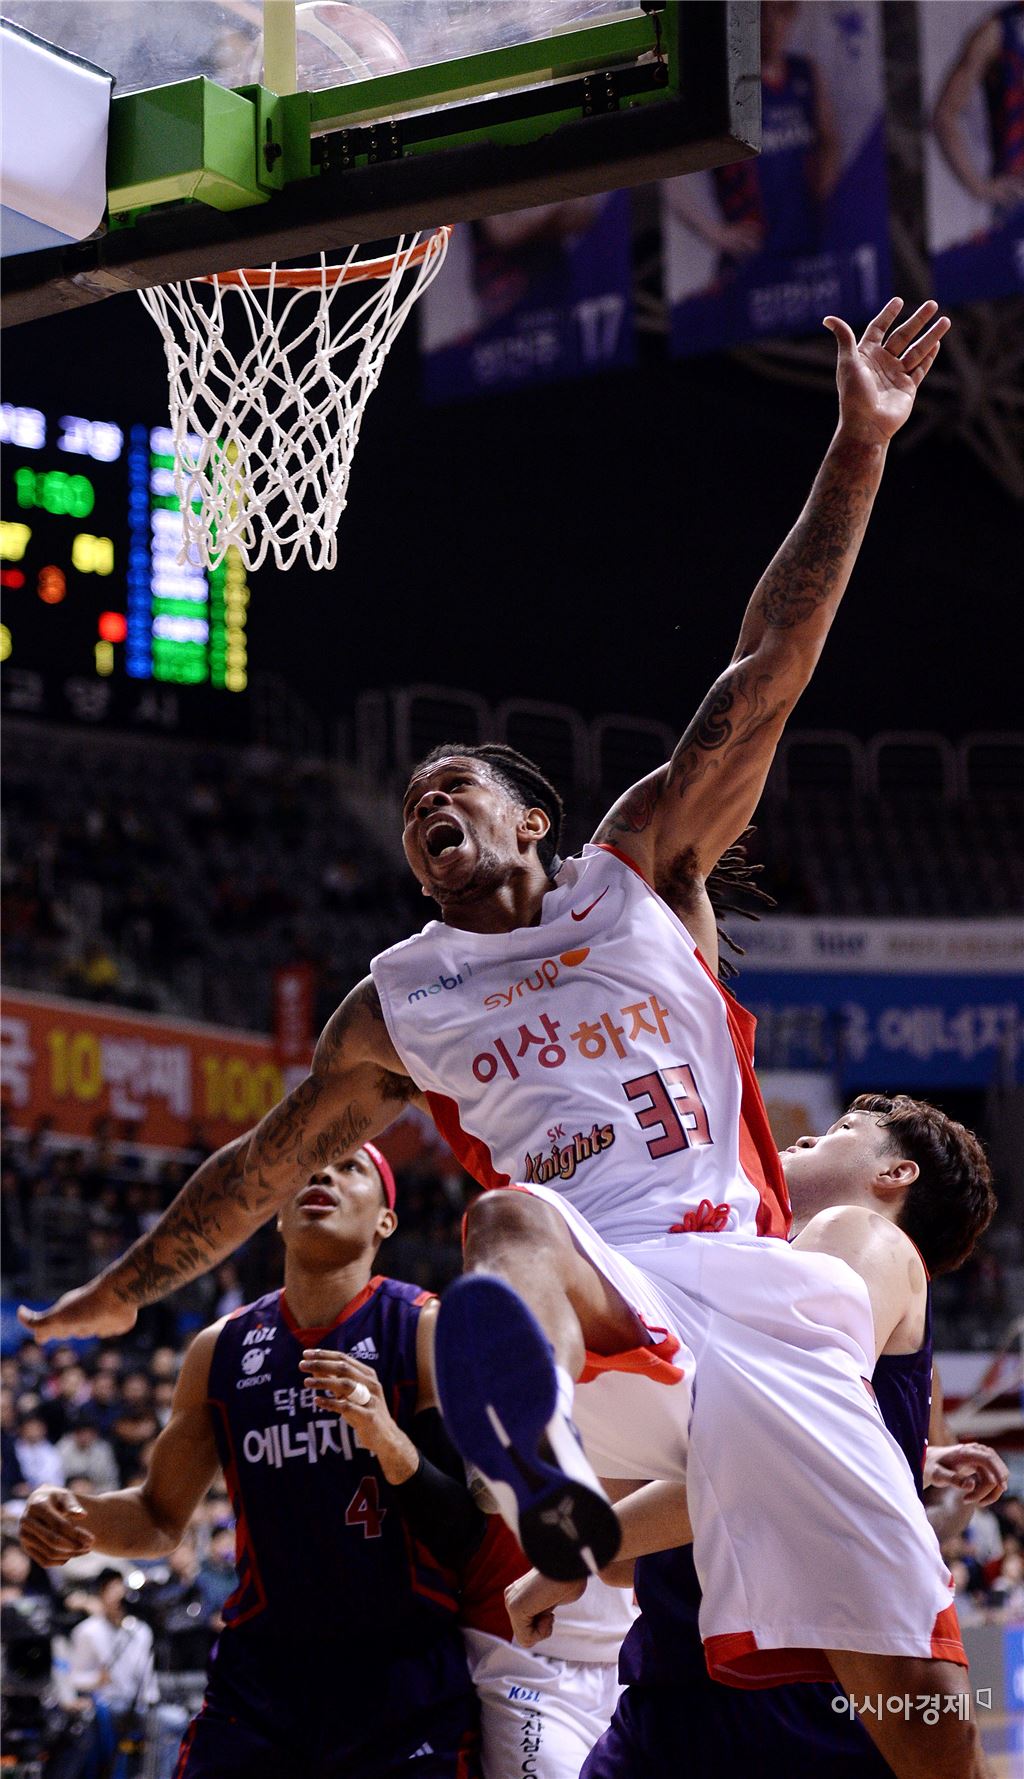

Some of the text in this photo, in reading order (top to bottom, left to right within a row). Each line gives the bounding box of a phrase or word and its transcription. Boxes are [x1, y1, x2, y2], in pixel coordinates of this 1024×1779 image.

[575, 293, 626, 362] 17
[483, 960, 559, 1010] syrup
[472, 992, 672, 1084] 이상하자
[547, 1123, 567, 1143] SK
[622, 1063, 714, 1160] 33
[524, 1123, 616, 1185] Knights
[235, 1373, 272, 1390] ORION
[273, 1387, 337, 1417] 닥터
[242, 1417, 377, 1469] 에너지
[345, 1475, 387, 1540] 4
